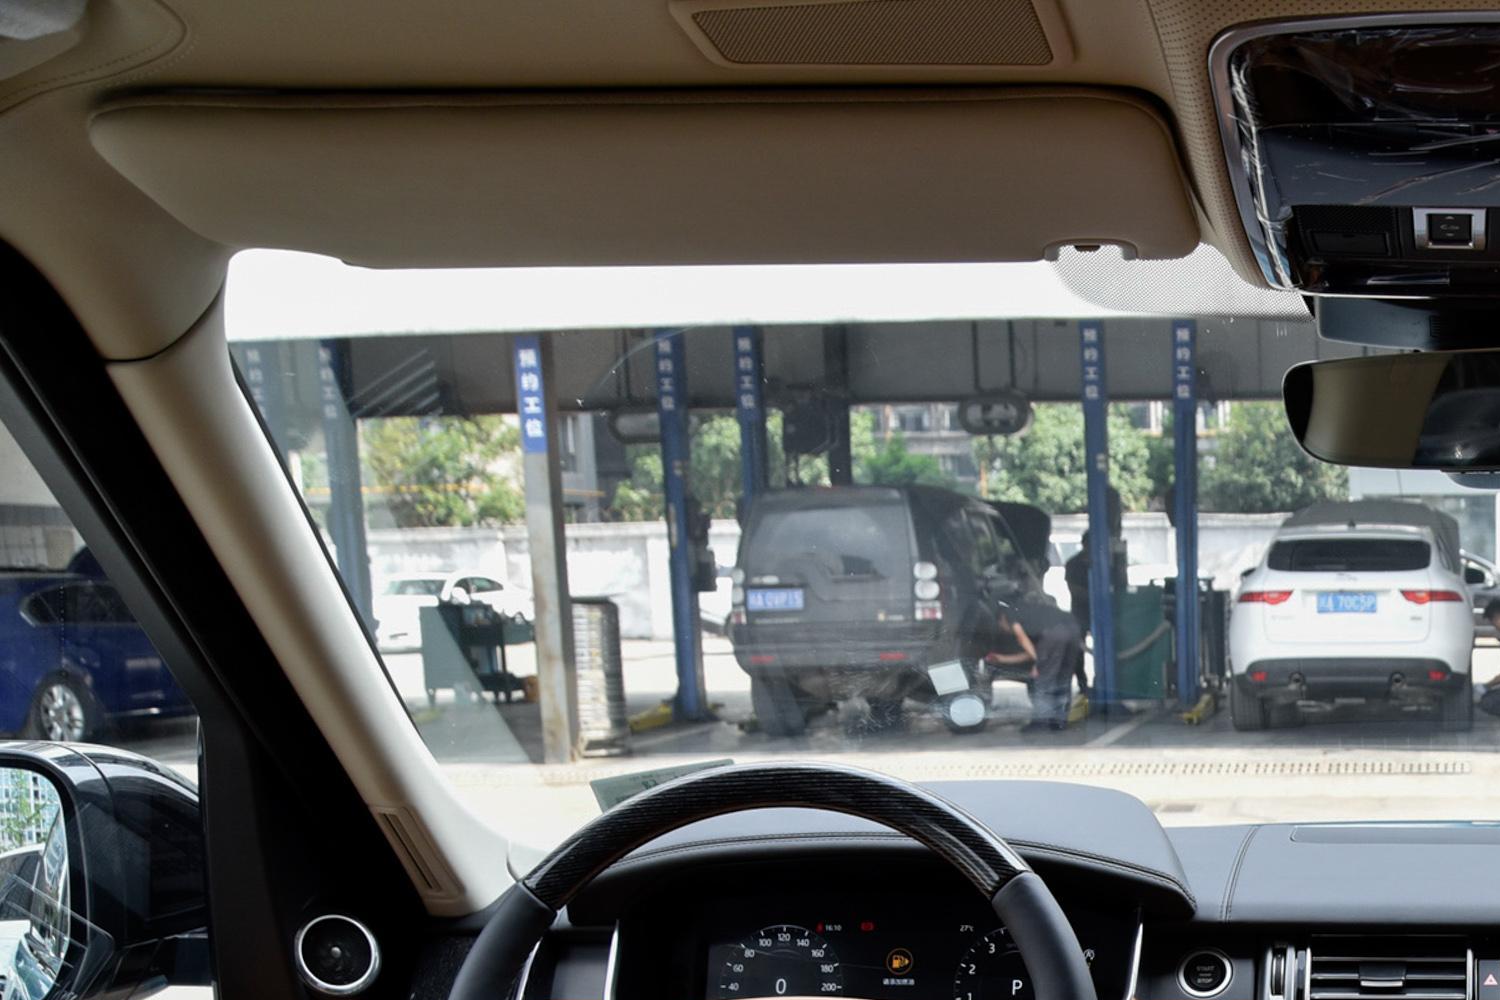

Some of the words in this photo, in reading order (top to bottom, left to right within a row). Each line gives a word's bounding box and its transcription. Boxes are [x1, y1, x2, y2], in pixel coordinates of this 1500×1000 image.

[777, 933, 791, 942] 120
[758, 938, 772, 947] 100
[796, 938, 810, 947] 140
[988, 943, 996, 954] 3
[744, 949, 755, 958] 80
[811, 949, 825, 958] 160
[732, 963, 744, 973] 60
[820, 964, 834, 973] 180
[968, 963, 976, 975] 2
[728, 982, 740, 991] 40
[775, 978, 787, 994] 0
[821, 982, 837, 991] 200
[1012, 979, 1023, 996] P
